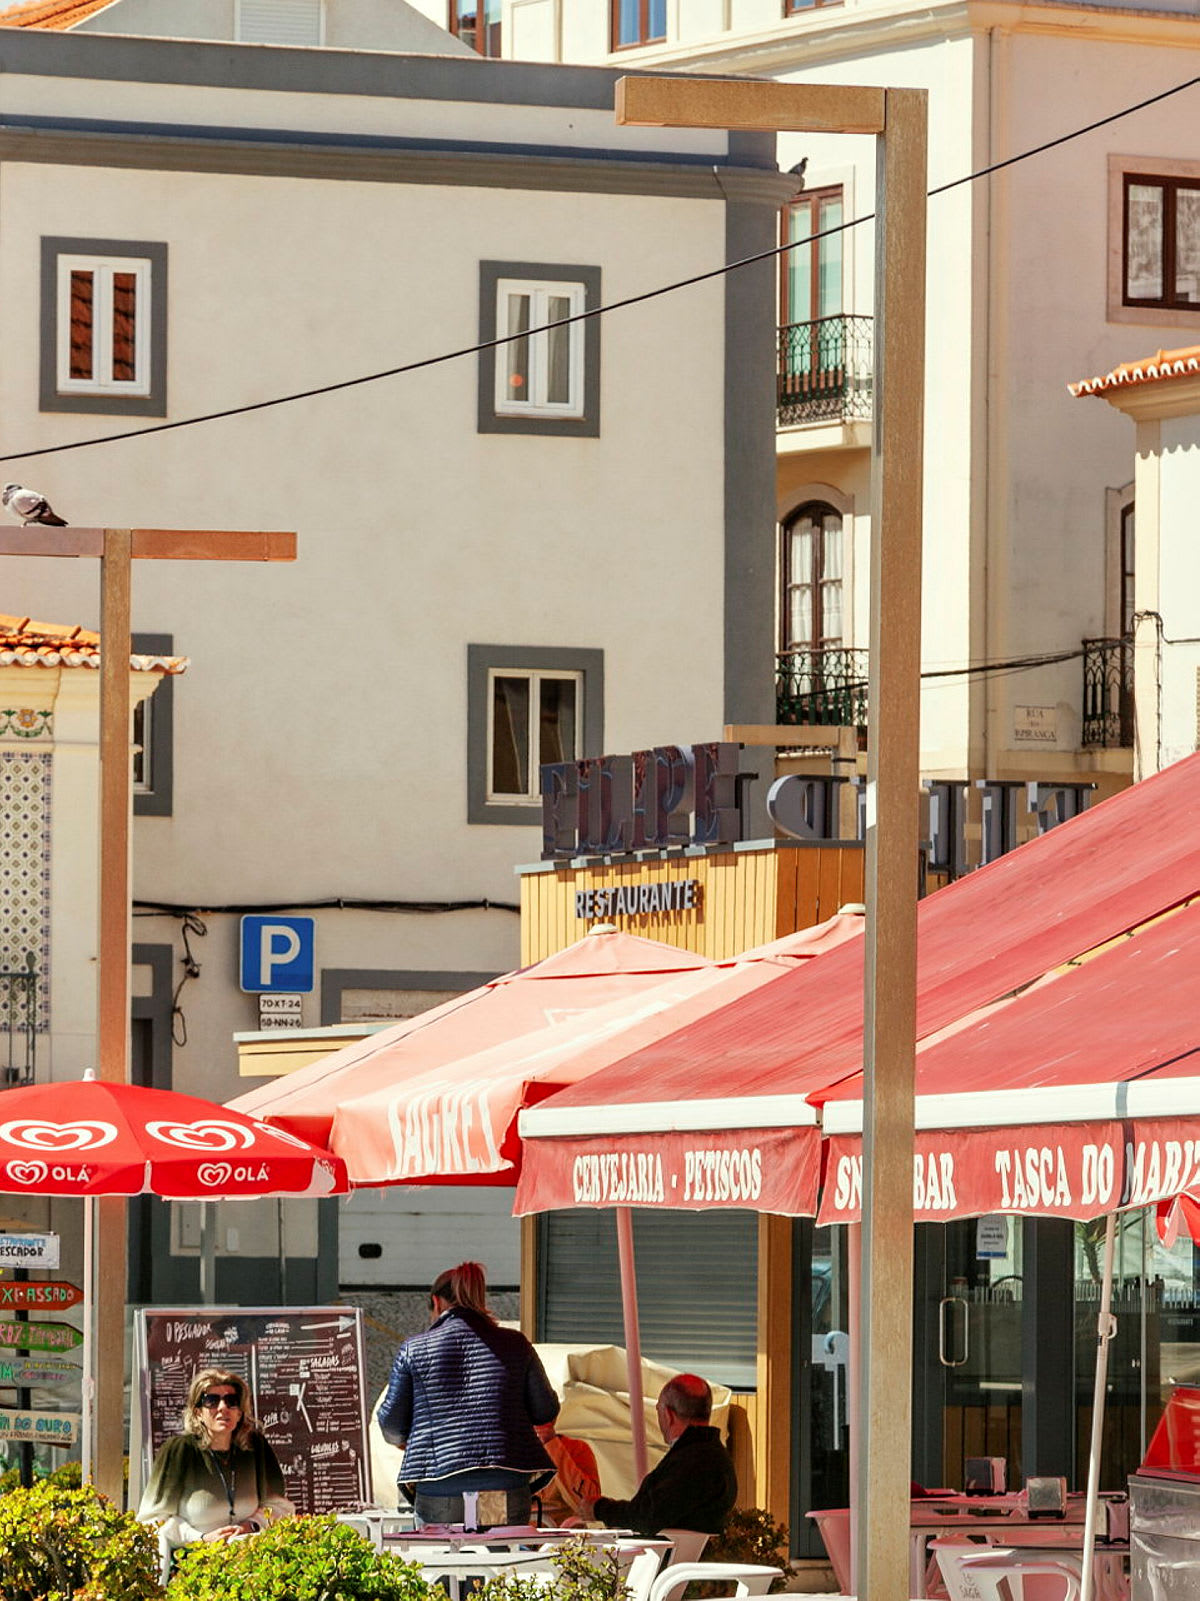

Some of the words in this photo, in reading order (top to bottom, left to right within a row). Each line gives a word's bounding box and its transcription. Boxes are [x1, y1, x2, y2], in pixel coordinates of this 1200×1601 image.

[575, 879, 699, 919] RESTAURANTE
[260, 925, 301, 985] P
[51, 1163, 91, 1182] OLÁ
[233, 1162, 270, 1182] OLÁ
[573, 1152, 665, 1203] CERVEJARIA
[683, 1147, 762, 1201] PETISCOS
[995, 1146, 1071, 1208] TASCA
[1081, 1143, 1114, 1205] DO
[26, 1287, 74, 1302] ASSADO
